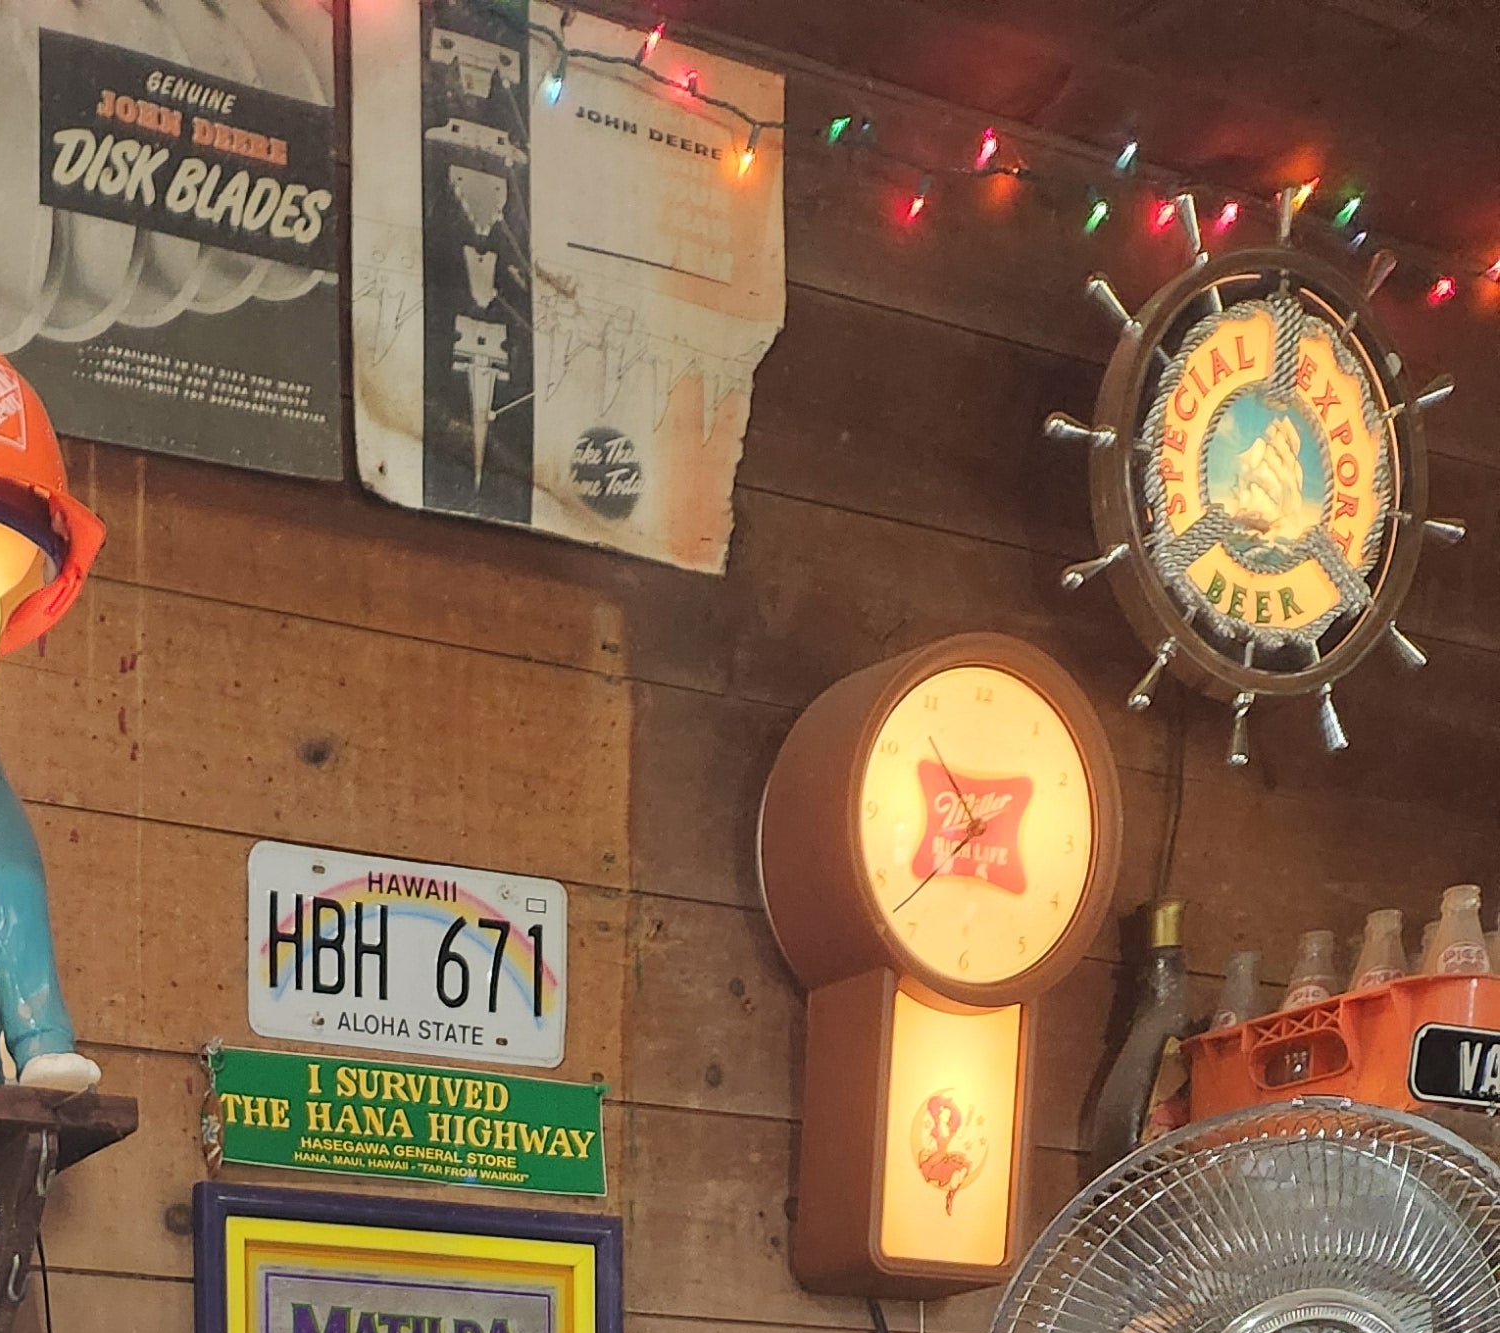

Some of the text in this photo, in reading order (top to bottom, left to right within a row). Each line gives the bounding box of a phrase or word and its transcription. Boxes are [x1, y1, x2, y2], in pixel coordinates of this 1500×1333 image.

[146, 70, 237, 116] GENUINE
[97, 89, 289, 167] JOHN DEERE
[575, 105, 725, 162] JOHN DEERE
[52, 127, 332, 245] DISK BLADES
[1159, 335, 1361, 560] SPECIAL EXPORT
[1206, 571, 1305, 625] BEER
[934, 792, 1013, 833] Miller
[933, 837, 1009, 866] HIGH LIFE
[367, 871, 457, 903] HAWAII
[269, 890, 543, 1017] HBH 671
[338, 1012, 484, 1047] ALOHA STATE
[308, 1064, 509, 1112] I SURVIVED
[221, 1094, 596, 1160] THE HANA HIGHWAY
[294, 1152, 331, 1165] HANA,
[333, 1155, 364, 1168] MAUI,
[368, 1158, 409, 1171] HAWAII
[444, 1165, 477, 1178] FROM
[301, 1136, 517, 1168] HASEGAWA GENERAL STORE
